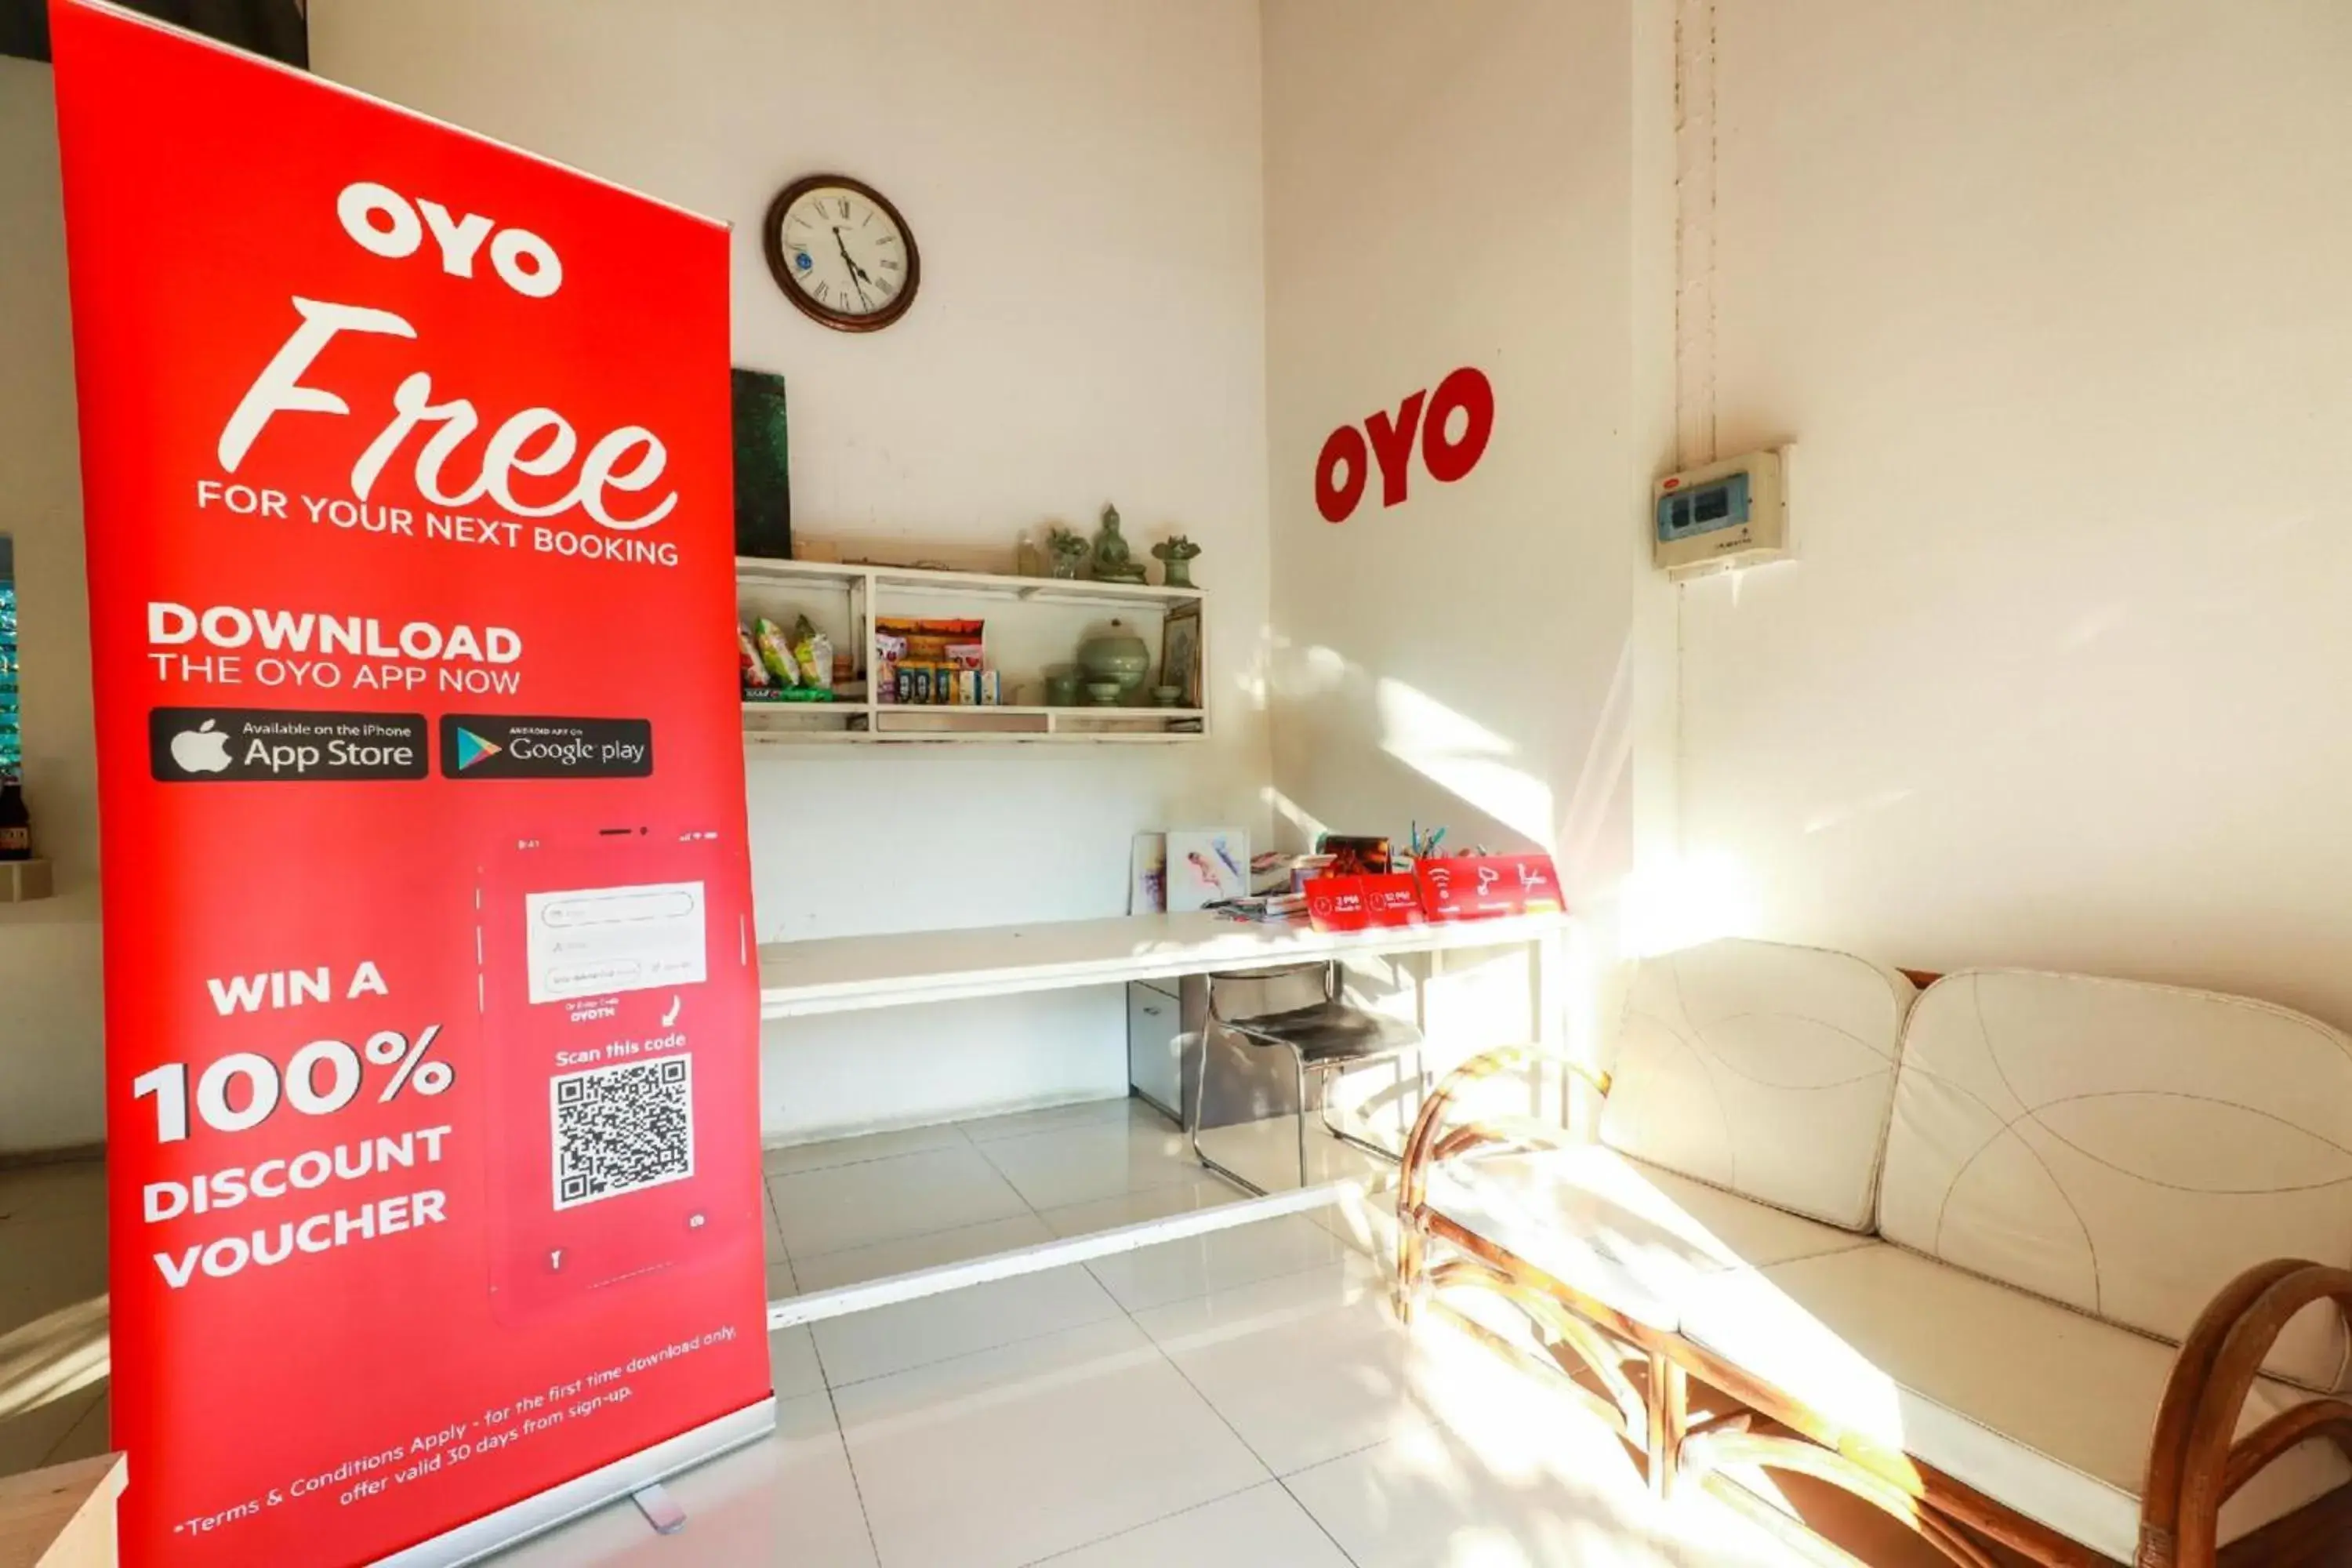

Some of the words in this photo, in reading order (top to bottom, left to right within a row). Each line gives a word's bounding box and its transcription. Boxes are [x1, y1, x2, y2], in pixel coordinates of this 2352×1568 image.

[337, 182, 563, 297] OYO
[217, 295, 678, 530] Free
[1315, 366, 1494, 523] OYO
[198, 479, 288, 519] FOR
[301, 495, 413, 537] YOUR
[426, 513, 522, 550] NEXT
[534, 528, 679, 567] BOOKING
[147, 602, 522, 665] DOWNLOAD
[147, 652, 242, 684] THE
[255, 659, 341, 688] OYO
[352, 666, 427, 692] APP
[439, 670, 521, 695] NOW
[242, 722, 311, 735] Available
[314, 724, 334, 735] on
[336, 723, 360, 736] the
[363, 724, 412, 737] iPhone
[244, 739, 320, 773] App
[328, 740, 414, 766] Store
[510, 738, 594, 765] Google
[602, 740, 644, 764] play
[207, 967, 331, 1016] WIN
[347, 961, 388, 999] A
[133, 1024, 456, 1145] 100%
[555, 1047, 601, 1067] Scan
[606, 1040, 640, 1059] this
[644, 1032, 687, 1051] code
[143, 1125, 452, 1223] DISCOUNT
[153, 1188, 447, 1290] VOUCHER
[266, 1488, 283, 1506] &
[290, 1446, 404, 1497] Conditions
[410, 1422, 466, 1453] Apply
[484, 1407, 511, 1426] for
[515, 1393, 544, 1414] the
[548, 1378, 582, 1403] first
[587, 1366, 622, 1388] time
[626, 1336, 700, 1374] download
[339, 1475, 389, 1505] offer
[394, 1453, 441, 1484] valid
[446, 1444, 471, 1465] 30
[475, 1428, 519, 1454] days
[523, 1411, 563, 1435] from
